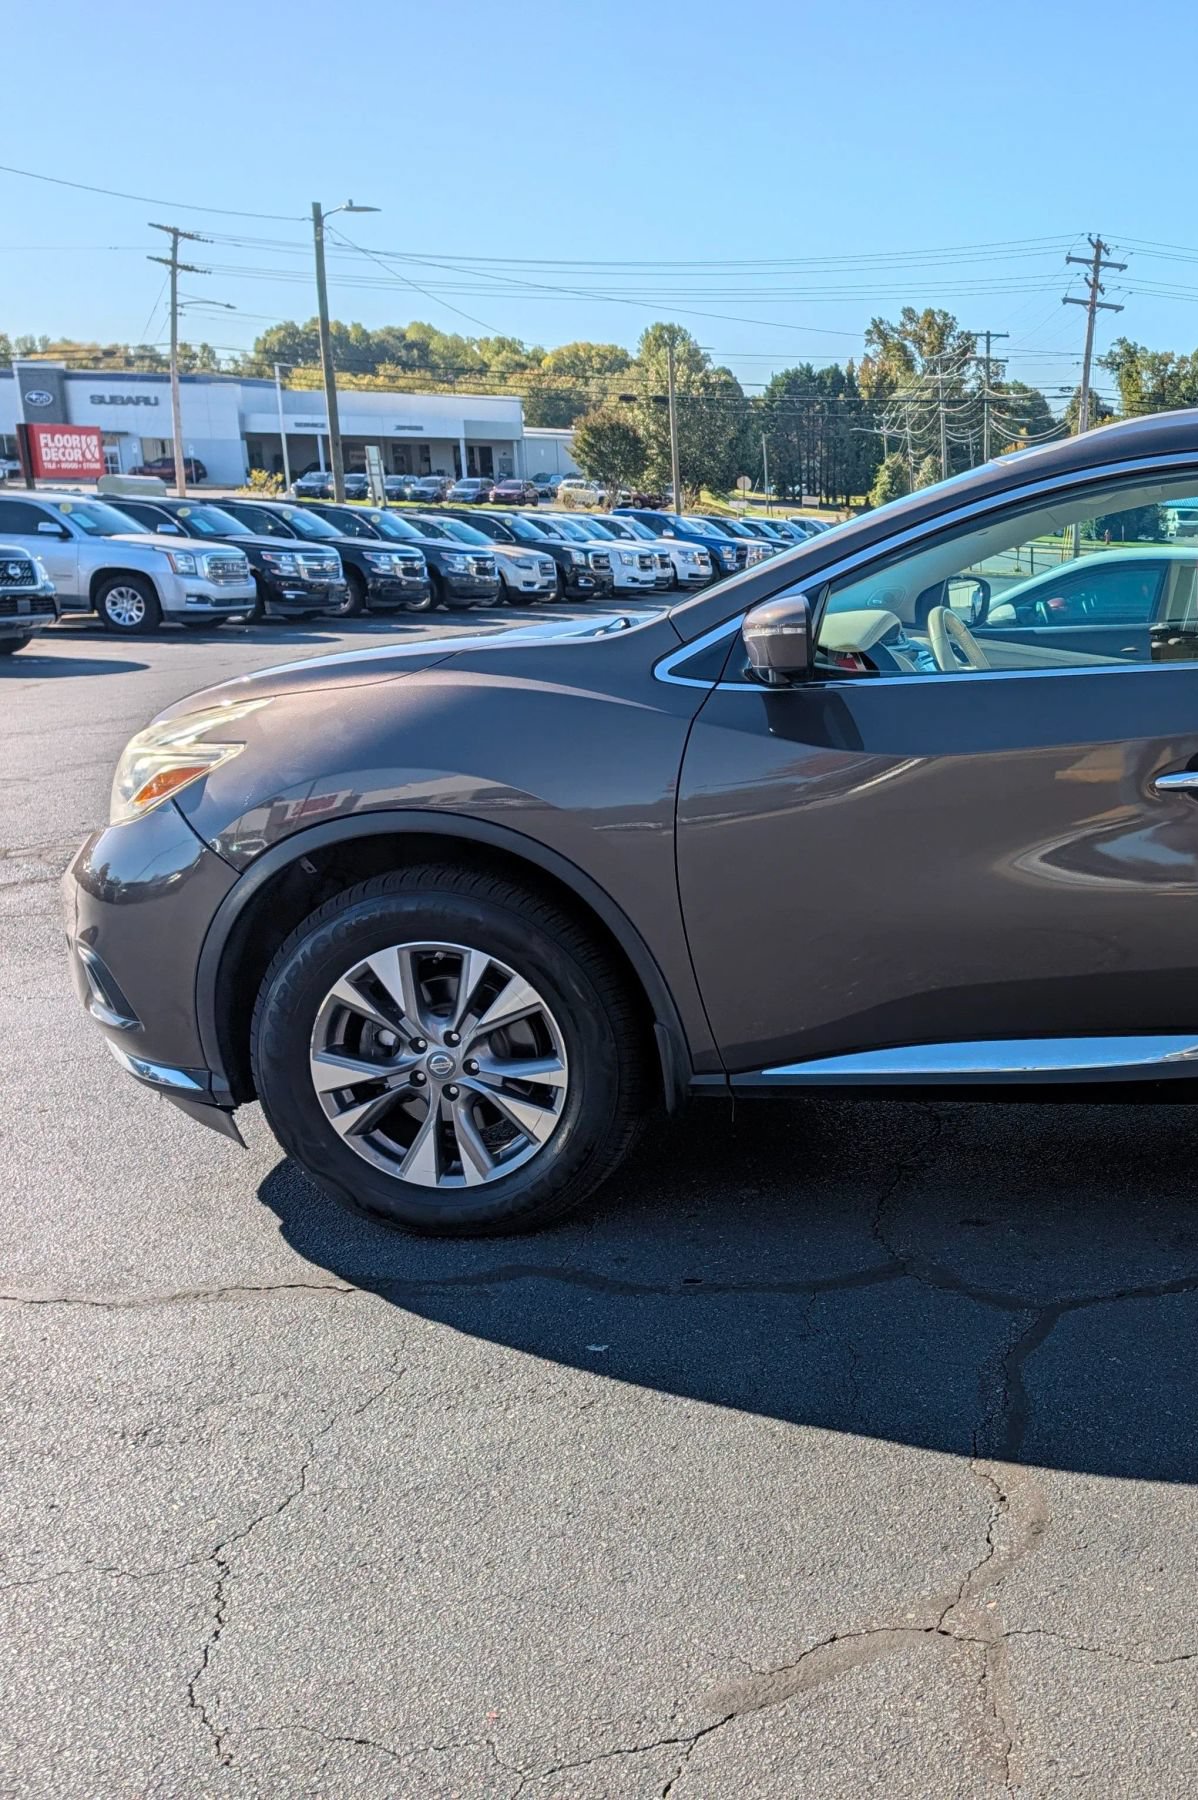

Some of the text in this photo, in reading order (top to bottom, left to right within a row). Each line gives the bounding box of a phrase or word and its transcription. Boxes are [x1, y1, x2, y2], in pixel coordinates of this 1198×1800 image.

[90, 394, 159, 406] SUBARU
[39, 433, 81, 447] FLOOR
[42, 448, 83, 461] DECOR
